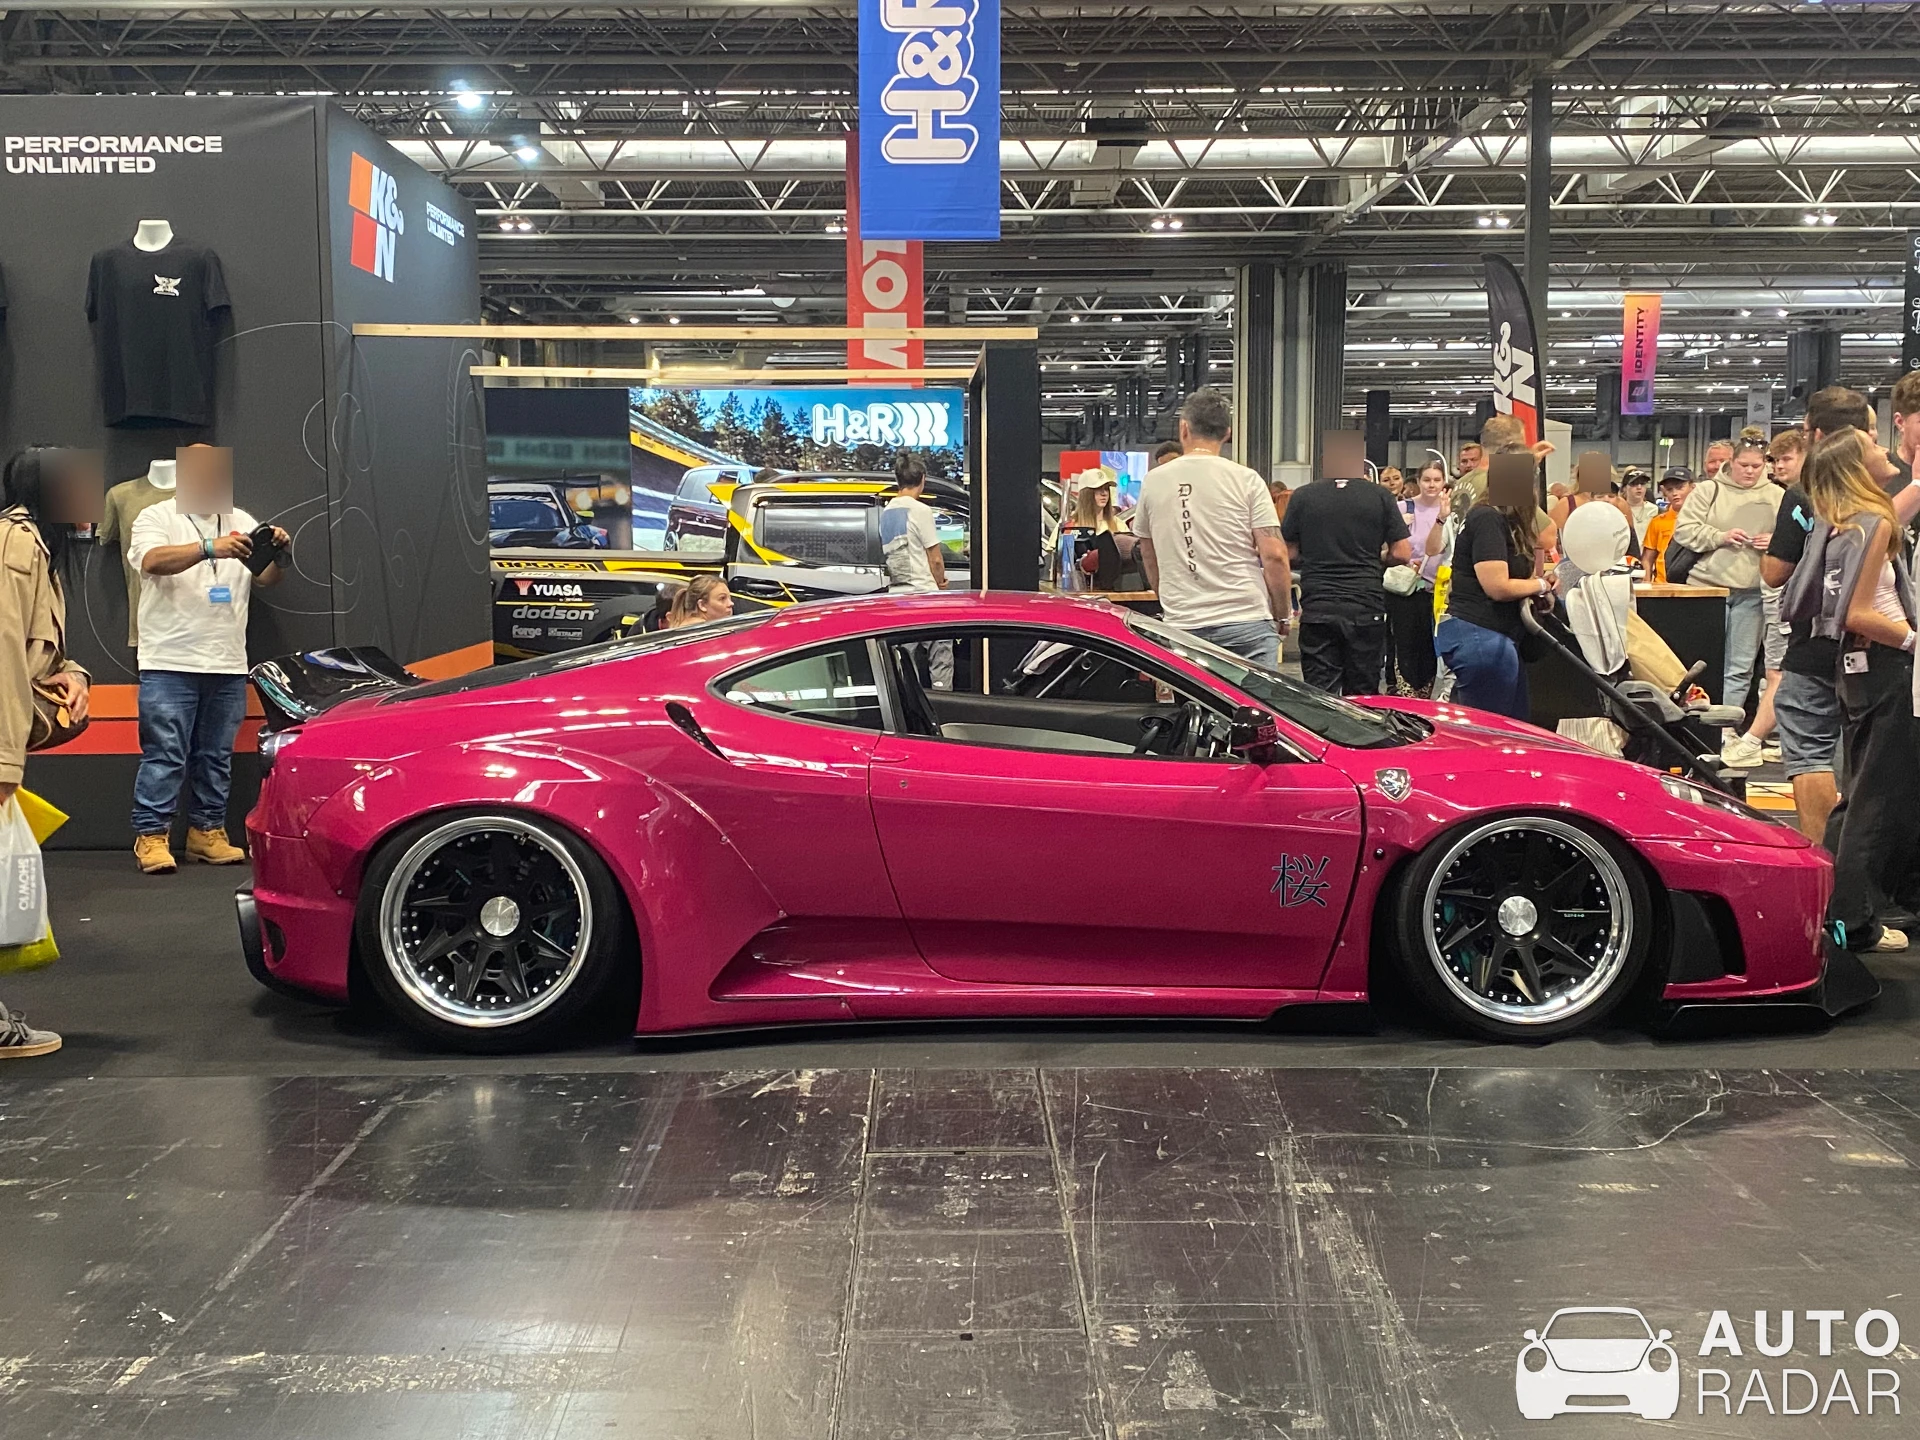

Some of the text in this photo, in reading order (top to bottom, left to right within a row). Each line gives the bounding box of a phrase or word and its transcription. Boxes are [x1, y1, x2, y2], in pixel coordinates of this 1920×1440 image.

[4, 136, 223, 154] PERFORMANCE
[5, 156, 157, 174] UNLIMITED
[426, 201, 465, 238] PERFORMANCE
[426, 217, 455, 247] UNLIMITED
[1634, 307, 1645, 374] IDENTITY
[812, 402, 904, 447] H&R
[1177, 483, 1198, 573] Dropped
[532, 584, 583, 597] YUASA
[512, 605, 595, 621] dodson
[1270, 852, 1331, 908] 桜
